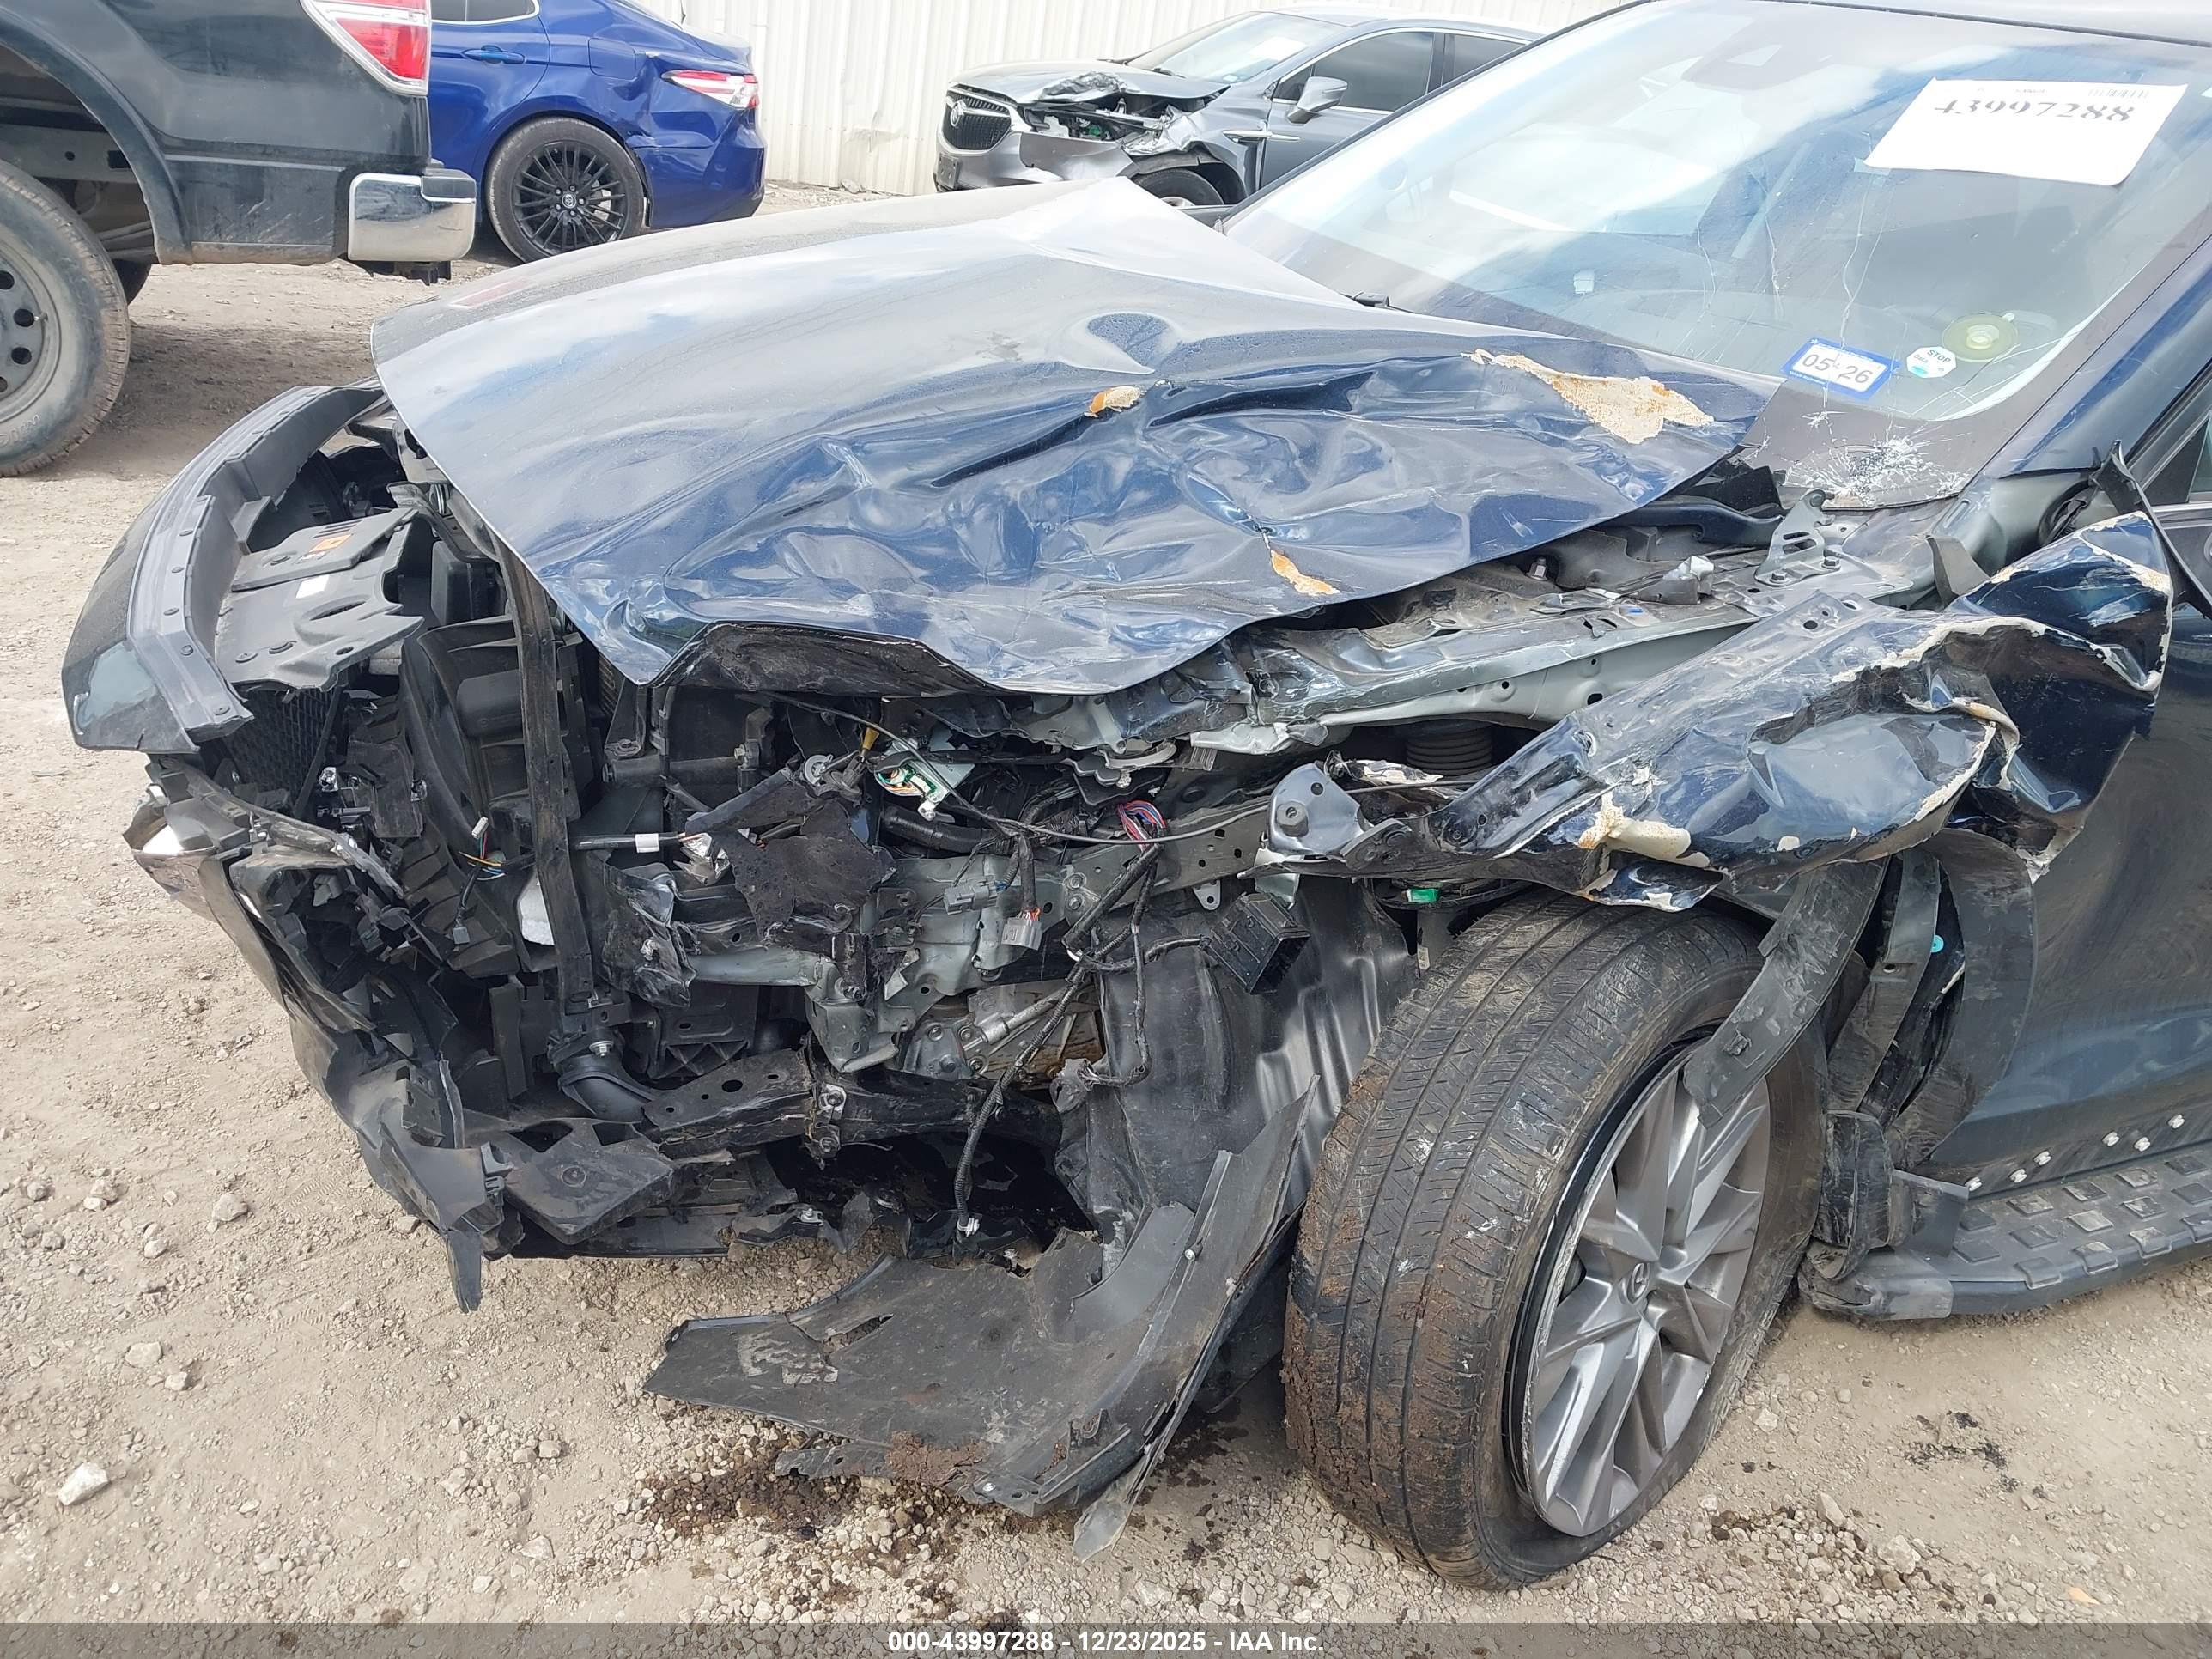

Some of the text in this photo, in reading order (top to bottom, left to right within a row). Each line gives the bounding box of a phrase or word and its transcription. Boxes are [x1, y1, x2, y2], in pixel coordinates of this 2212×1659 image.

[1934, 98, 2135, 122] 43997288
[1927, 349, 1951, 363] STOP
[1802, 353, 1836, 371] 05
[1838, 365, 1874, 384] 26
